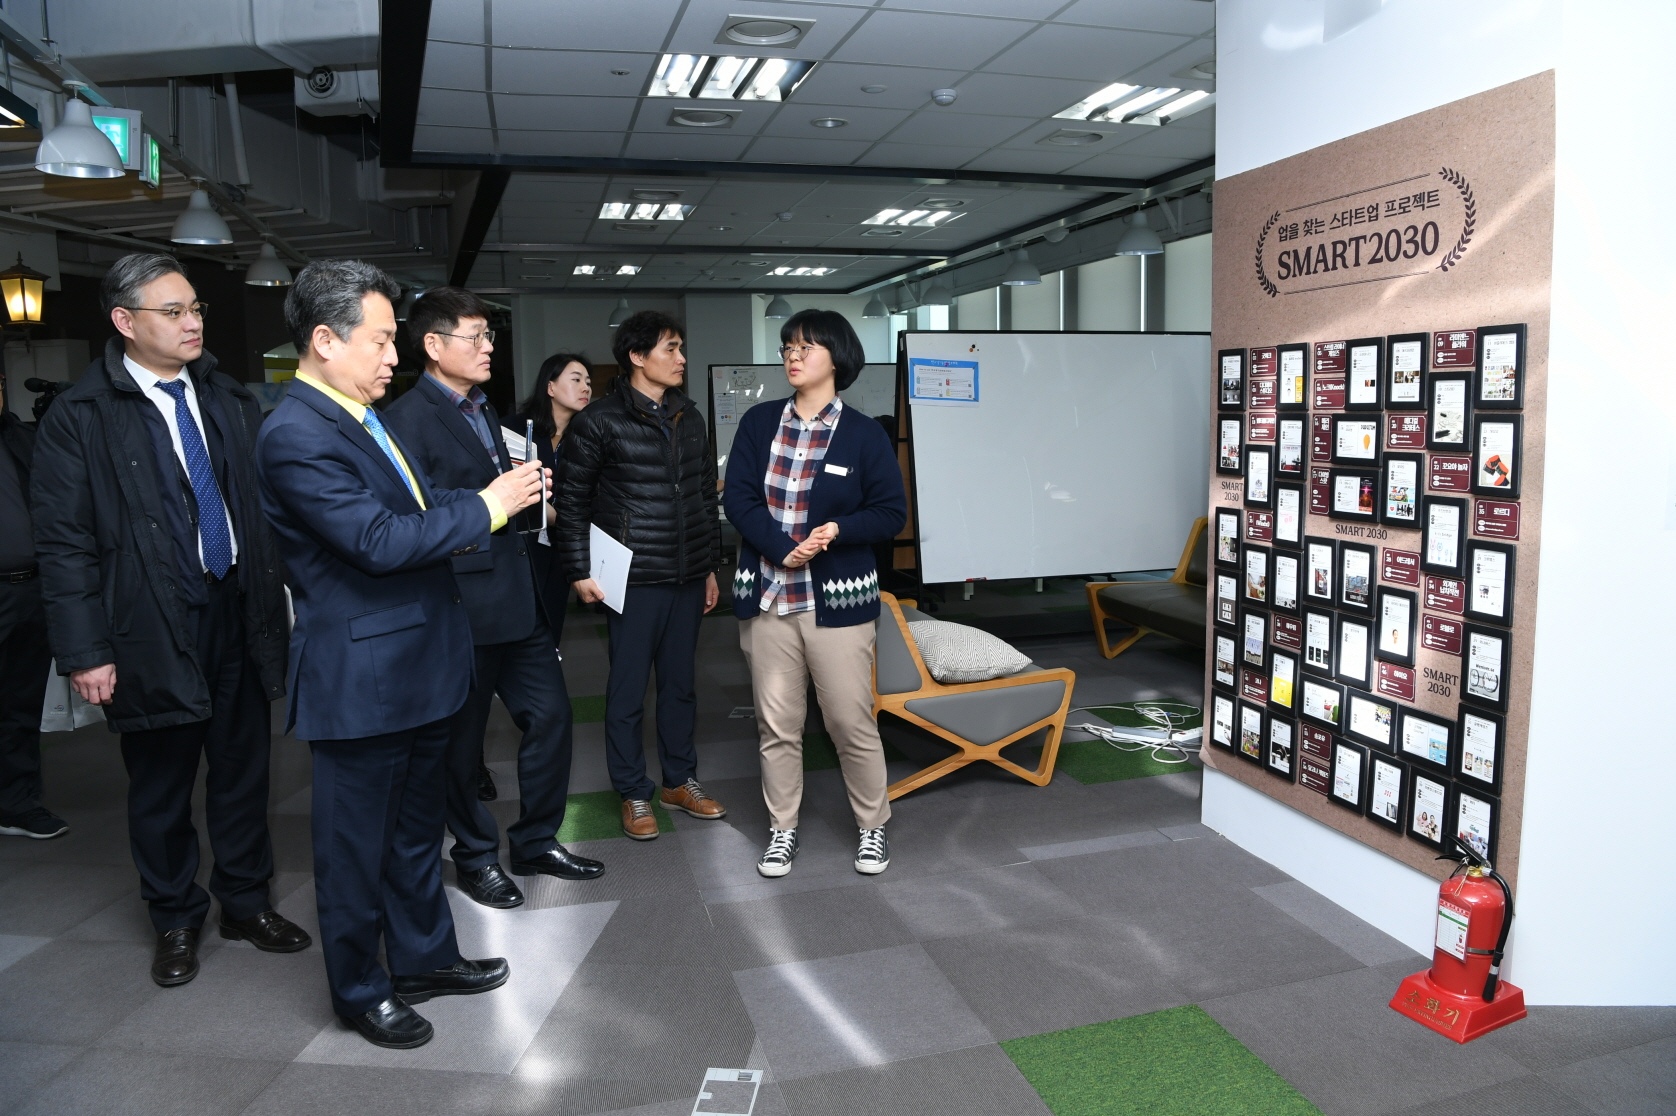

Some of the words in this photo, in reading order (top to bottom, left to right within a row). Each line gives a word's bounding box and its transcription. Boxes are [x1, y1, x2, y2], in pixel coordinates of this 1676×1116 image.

[1278, 222, 1299, 242] 업을
[1303, 218, 1325, 237] 찾는
[1329, 203, 1379, 230] 스타트업
[1384, 189, 1441, 218] 프로젝트
[1278, 221, 1440, 280] SMART2030
[1222, 481, 1243, 492] SMART
[1224, 492, 1239, 501] 2030
[1335, 523, 1365, 537] SMART
[1366, 529, 1388, 540] 2030
[1423, 667, 1458, 686] SMART
[1427, 681, 1451, 698] 2030
[1404, 990, 1460, 1026] 소화기
